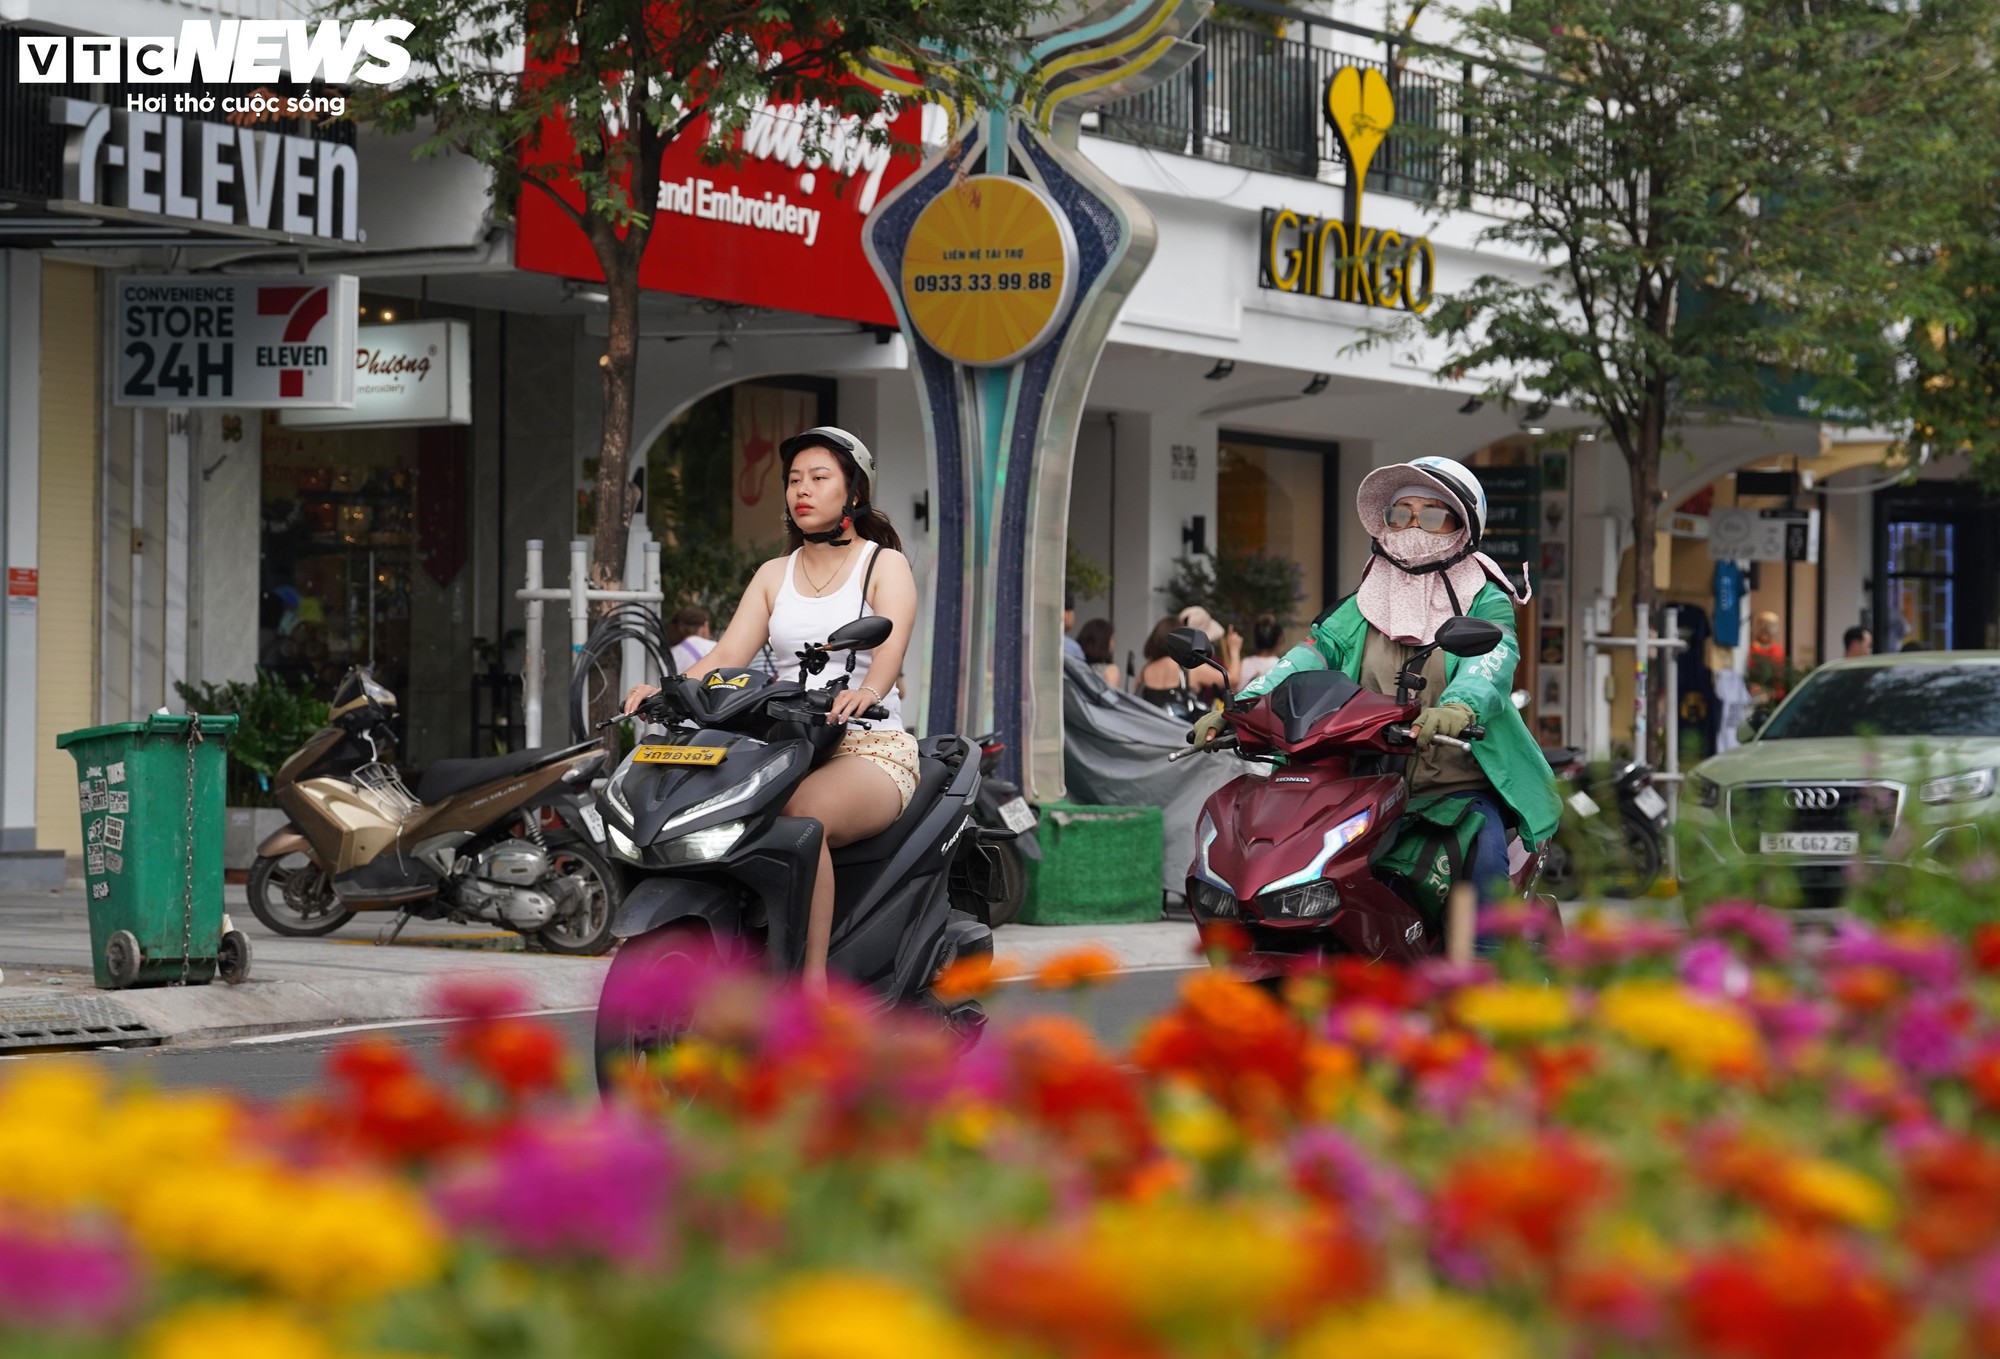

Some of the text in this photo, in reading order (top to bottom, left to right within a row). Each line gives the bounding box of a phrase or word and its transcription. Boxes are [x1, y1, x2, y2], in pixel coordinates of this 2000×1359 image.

[696, 178, 821, 246] Embroidery
[124, 286, 235, 302] CONVENIENCE
[914, 272, 1053, 293] 0933.33.99.88
[125, 304, 235, 339] STORE
[123, 340, 234, 398] 24H
